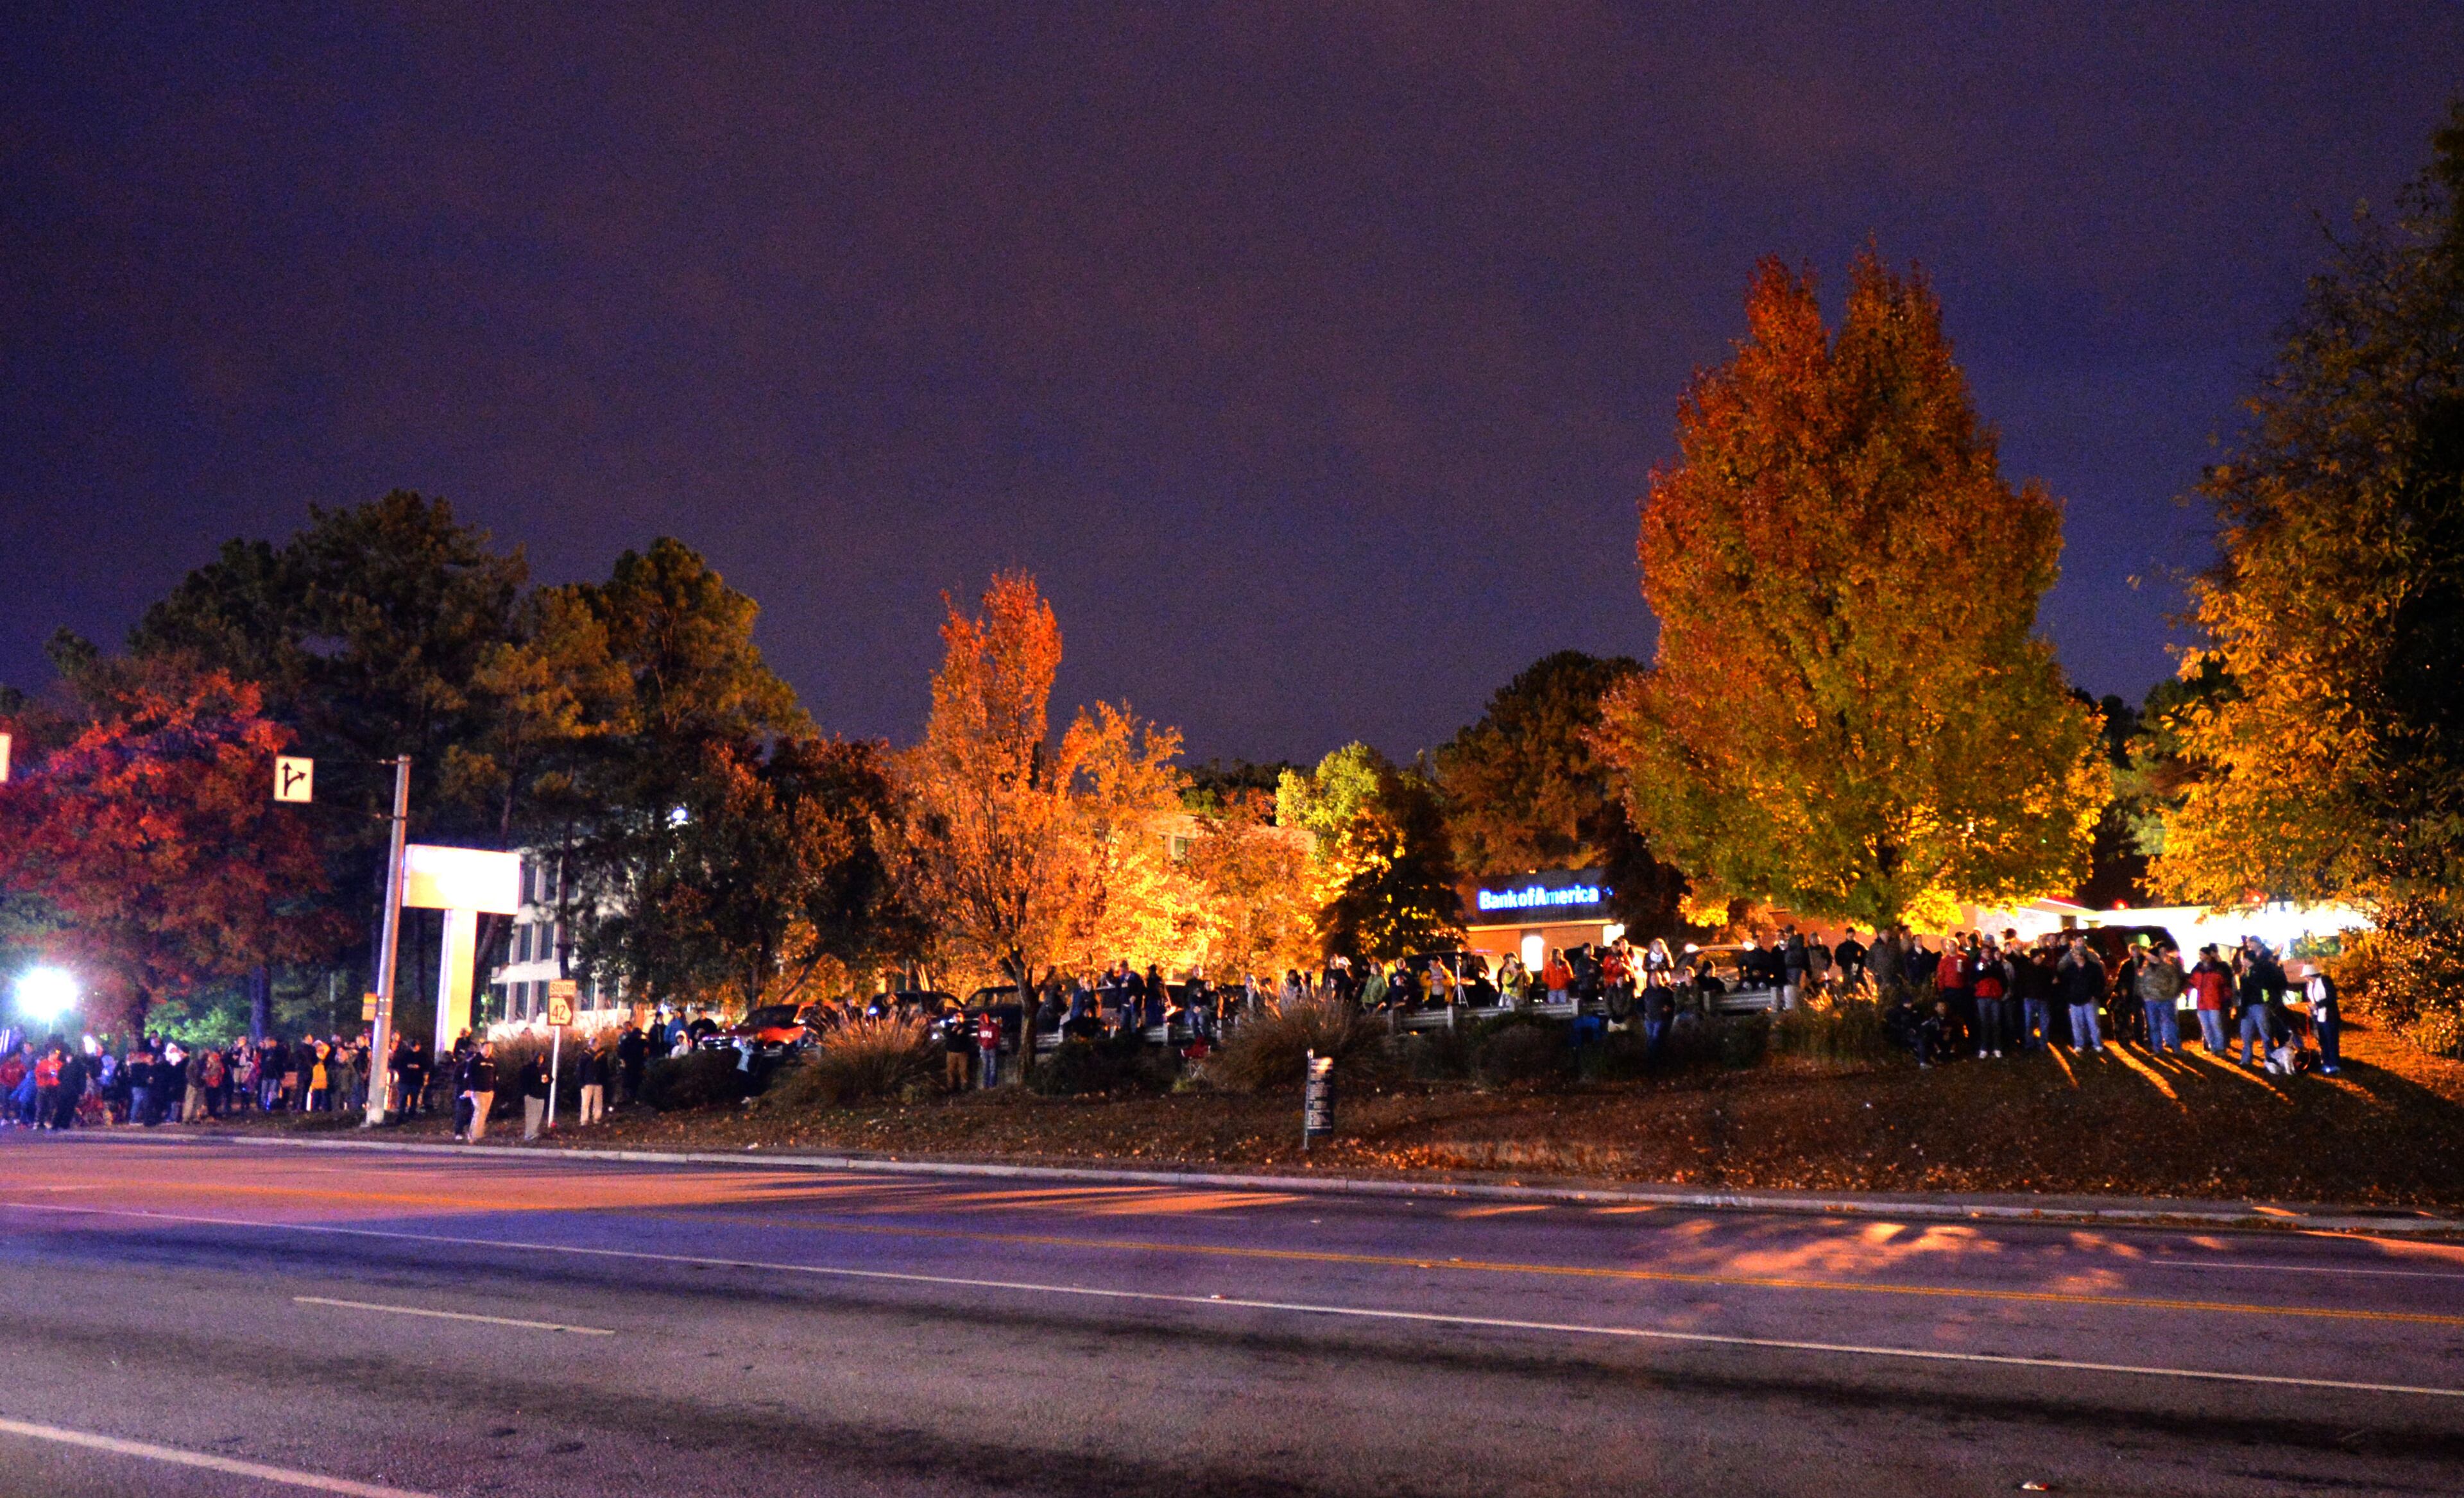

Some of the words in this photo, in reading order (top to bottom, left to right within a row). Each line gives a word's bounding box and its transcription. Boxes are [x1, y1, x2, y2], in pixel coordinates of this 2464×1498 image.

[1479, 889, 1518, 910] Bank
[1518, 886, 1535, 907] of
[1535, 884, 1599, 906] America
[551, 983, 574, 993] SOUTH
[552, 1004, 566, 1020] 42
